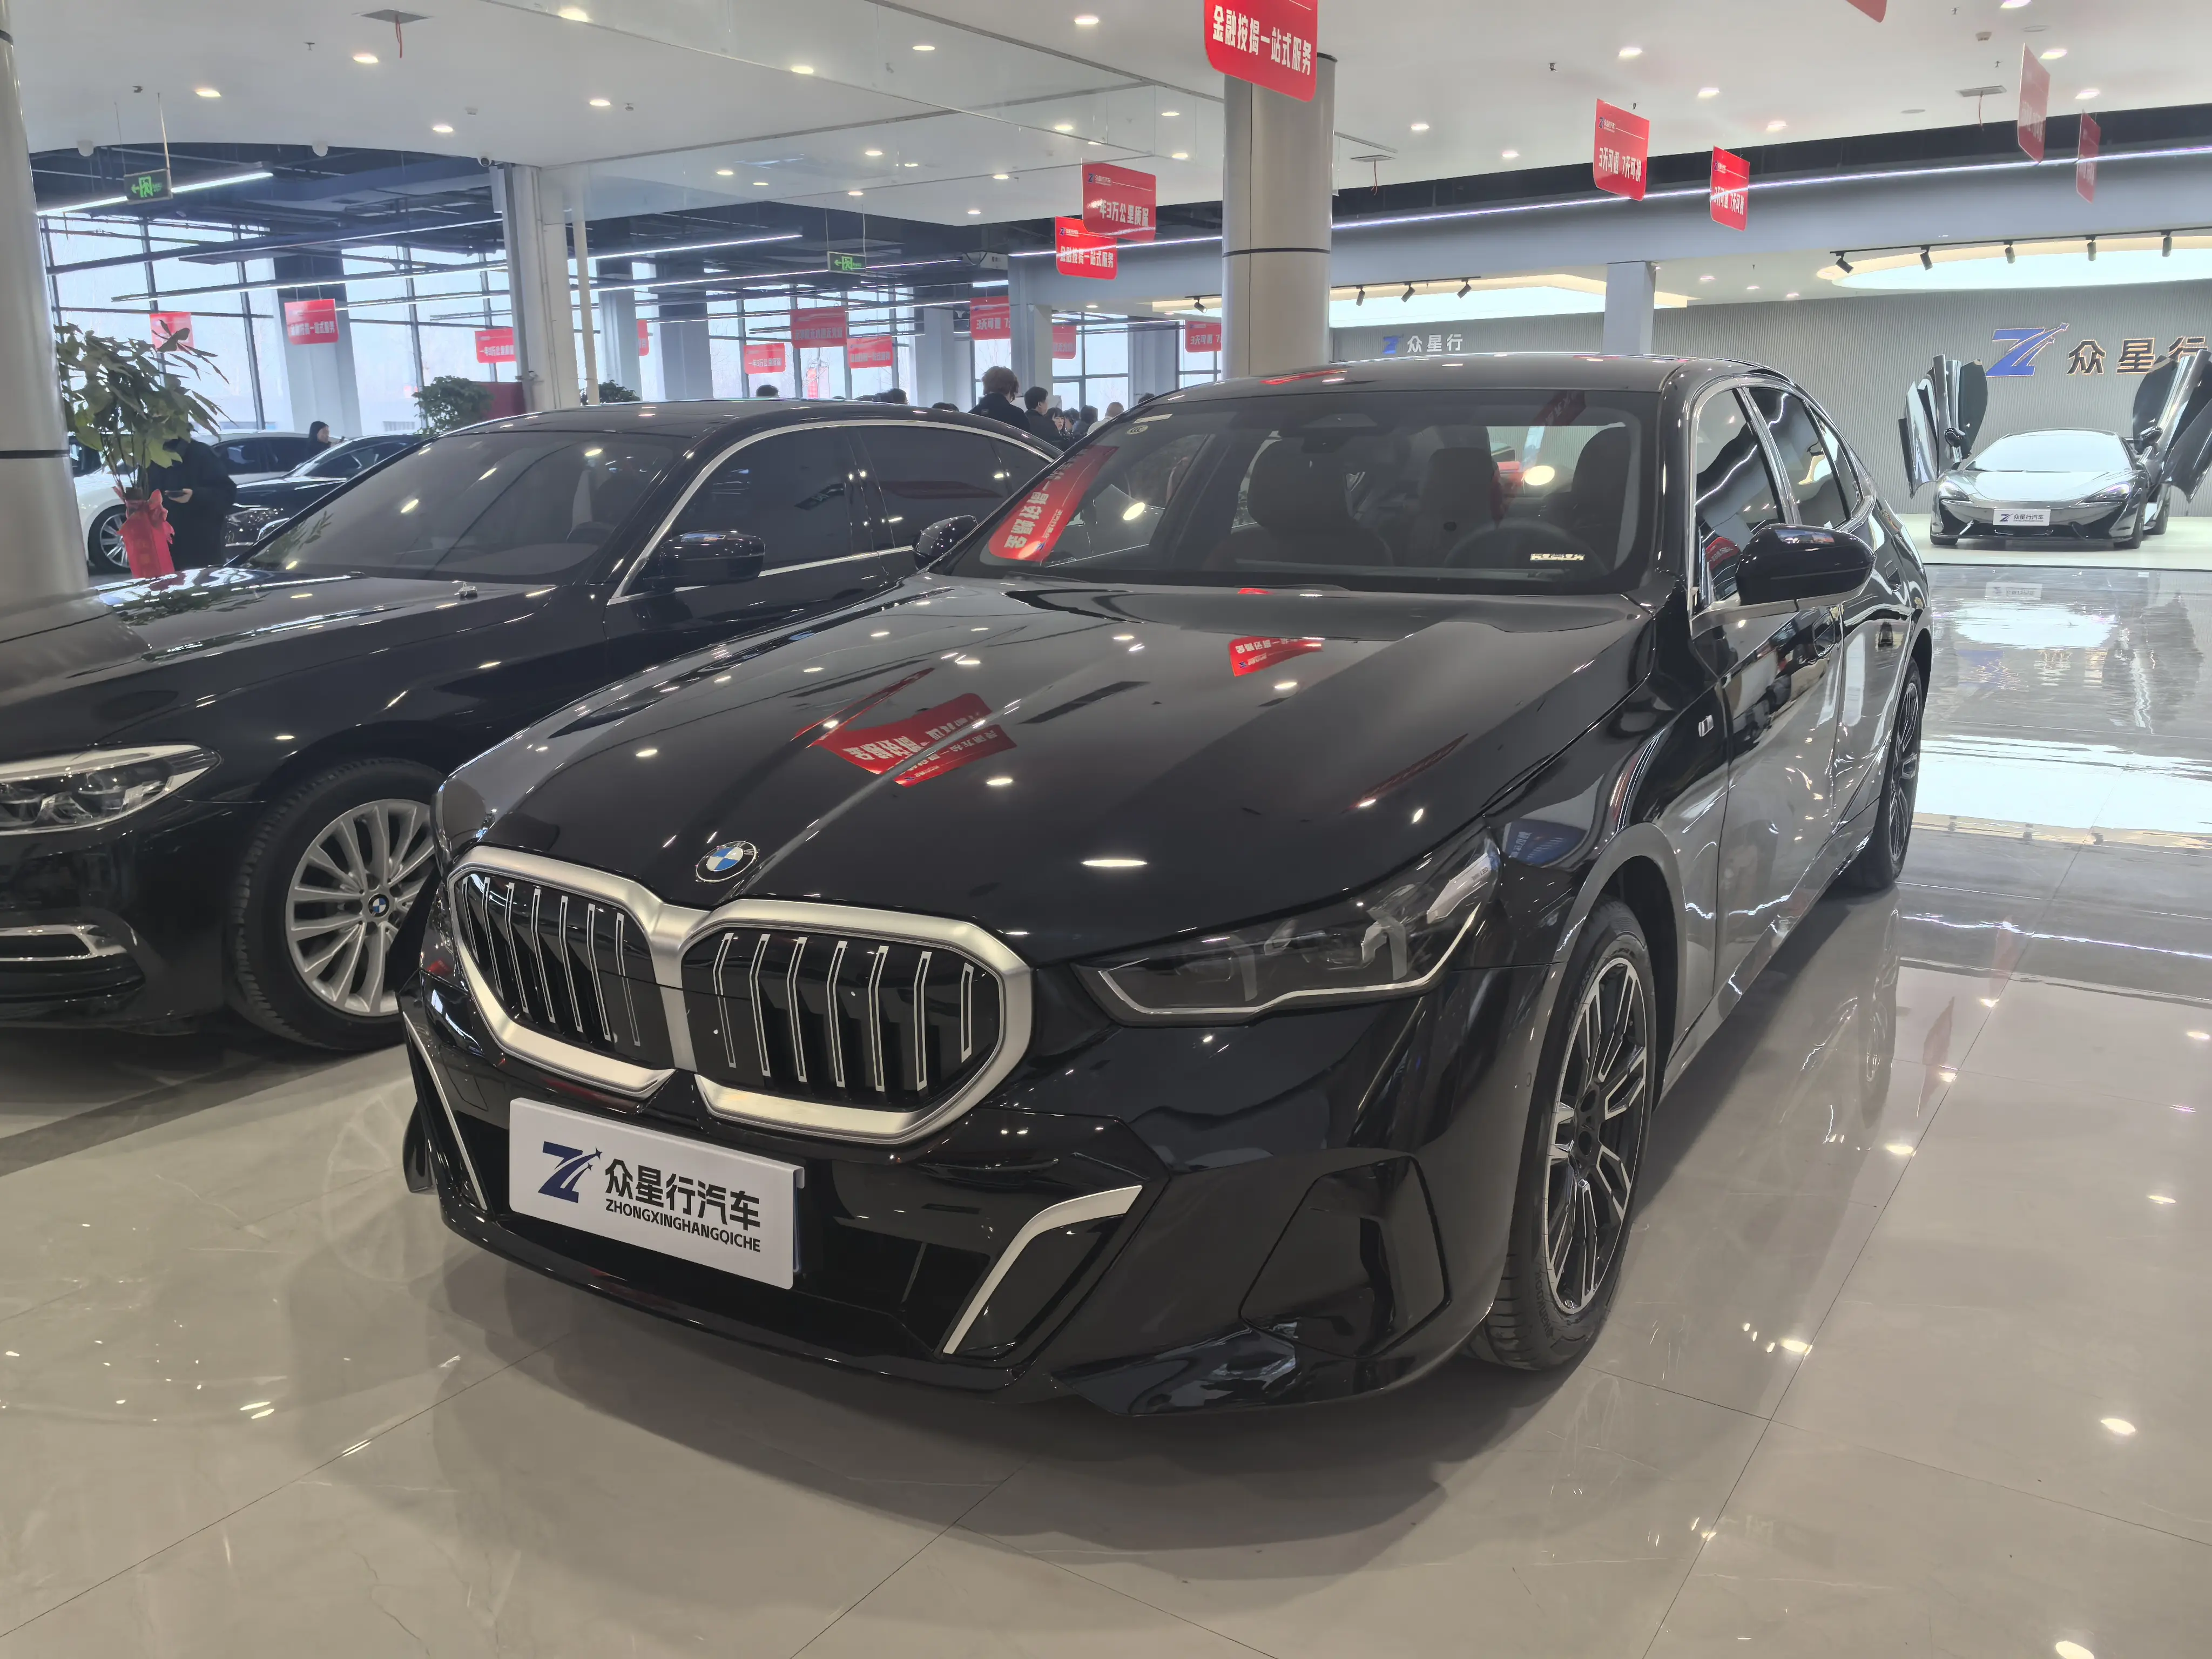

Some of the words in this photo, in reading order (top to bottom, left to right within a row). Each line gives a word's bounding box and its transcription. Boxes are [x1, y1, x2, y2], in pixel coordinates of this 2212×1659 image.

[1212, 4, 1312, 75] 金融按揭一站式服务
[1090, 199, 1149, 227] 年3万公里质保
[1407, 333, 1464, 353] 众星行
[605, 1158, 760, 1231] 众星行汽车
[605, 1199, 760, 1252] ZHONGXINGHANGQICHE
